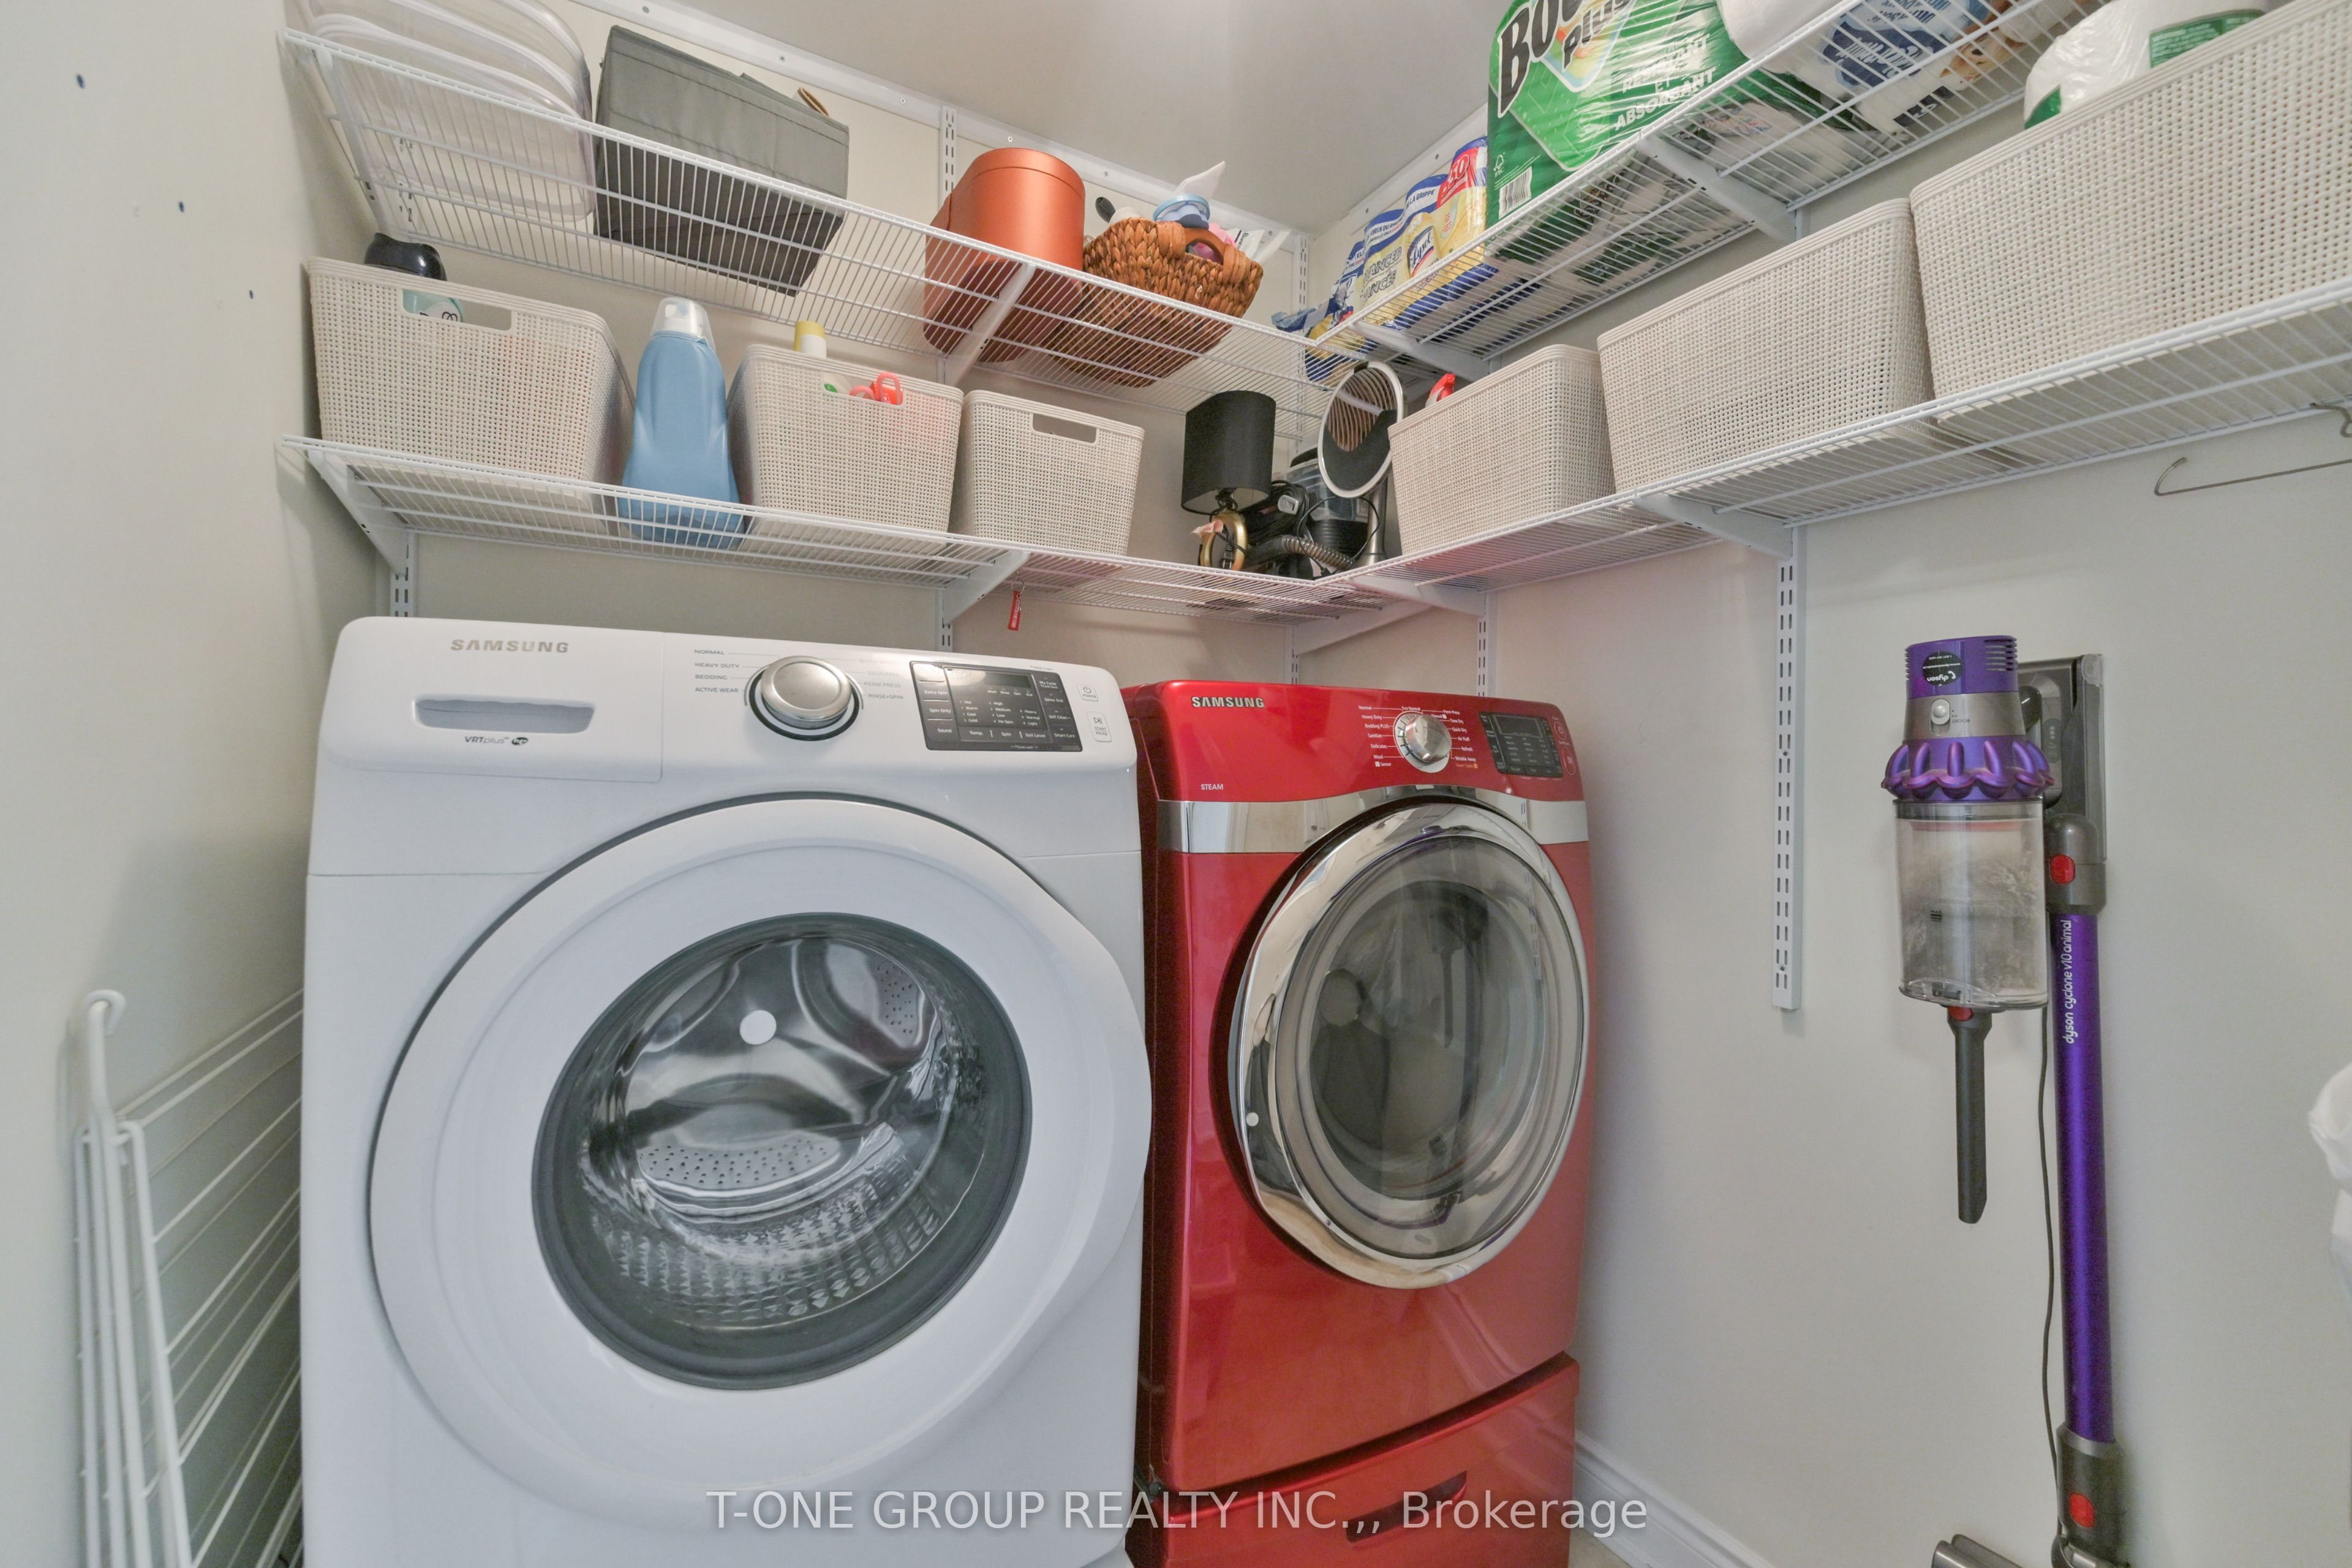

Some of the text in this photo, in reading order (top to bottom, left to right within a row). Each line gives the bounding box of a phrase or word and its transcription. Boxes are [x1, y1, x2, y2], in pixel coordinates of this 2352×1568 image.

[1411, 232, 1433, 265] Lysol
[451, 639, 569, 654] SAMSUNG
[1191, 696, 1265, 708] SAMSUNG
[2060, 919, 2078, 1044] dyson cyclone v10 animal
